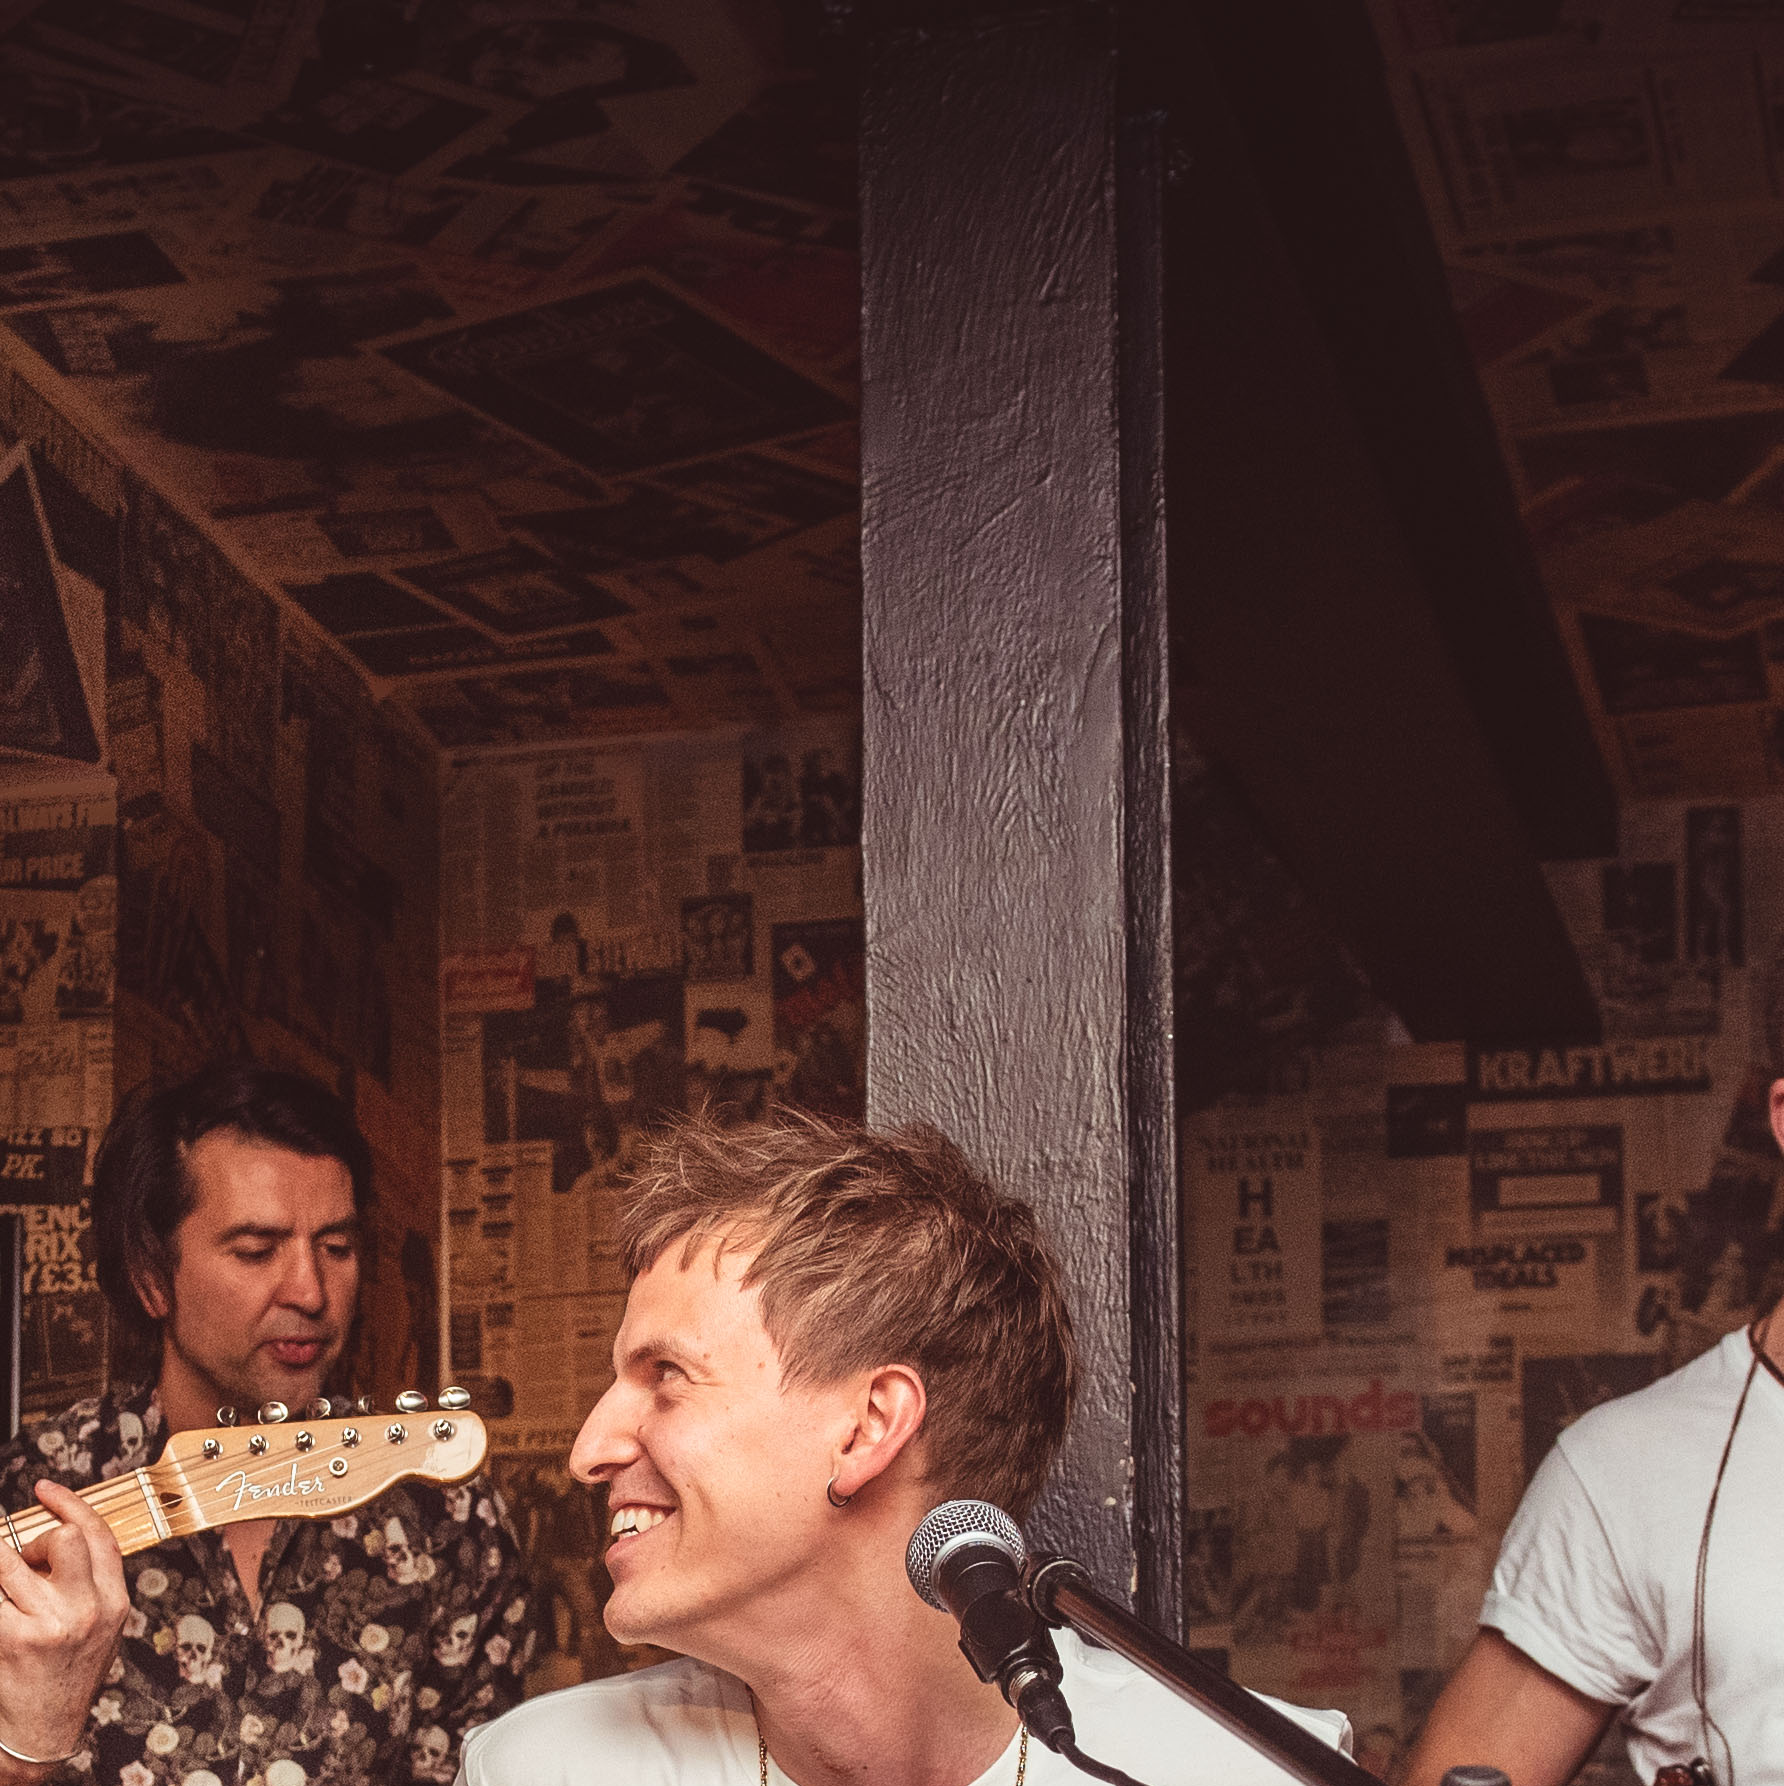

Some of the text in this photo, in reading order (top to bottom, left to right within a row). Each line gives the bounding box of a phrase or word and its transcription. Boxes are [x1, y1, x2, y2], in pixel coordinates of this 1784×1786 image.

[26, 852, 86, 881] PRICE
[1237, 1175, 1274, 1219] H
[1233, 1226, 1281, 1254] EA
[1204, 1379, 1418, 1440] sounds
[215, 1463, 326, 1512] Fender
